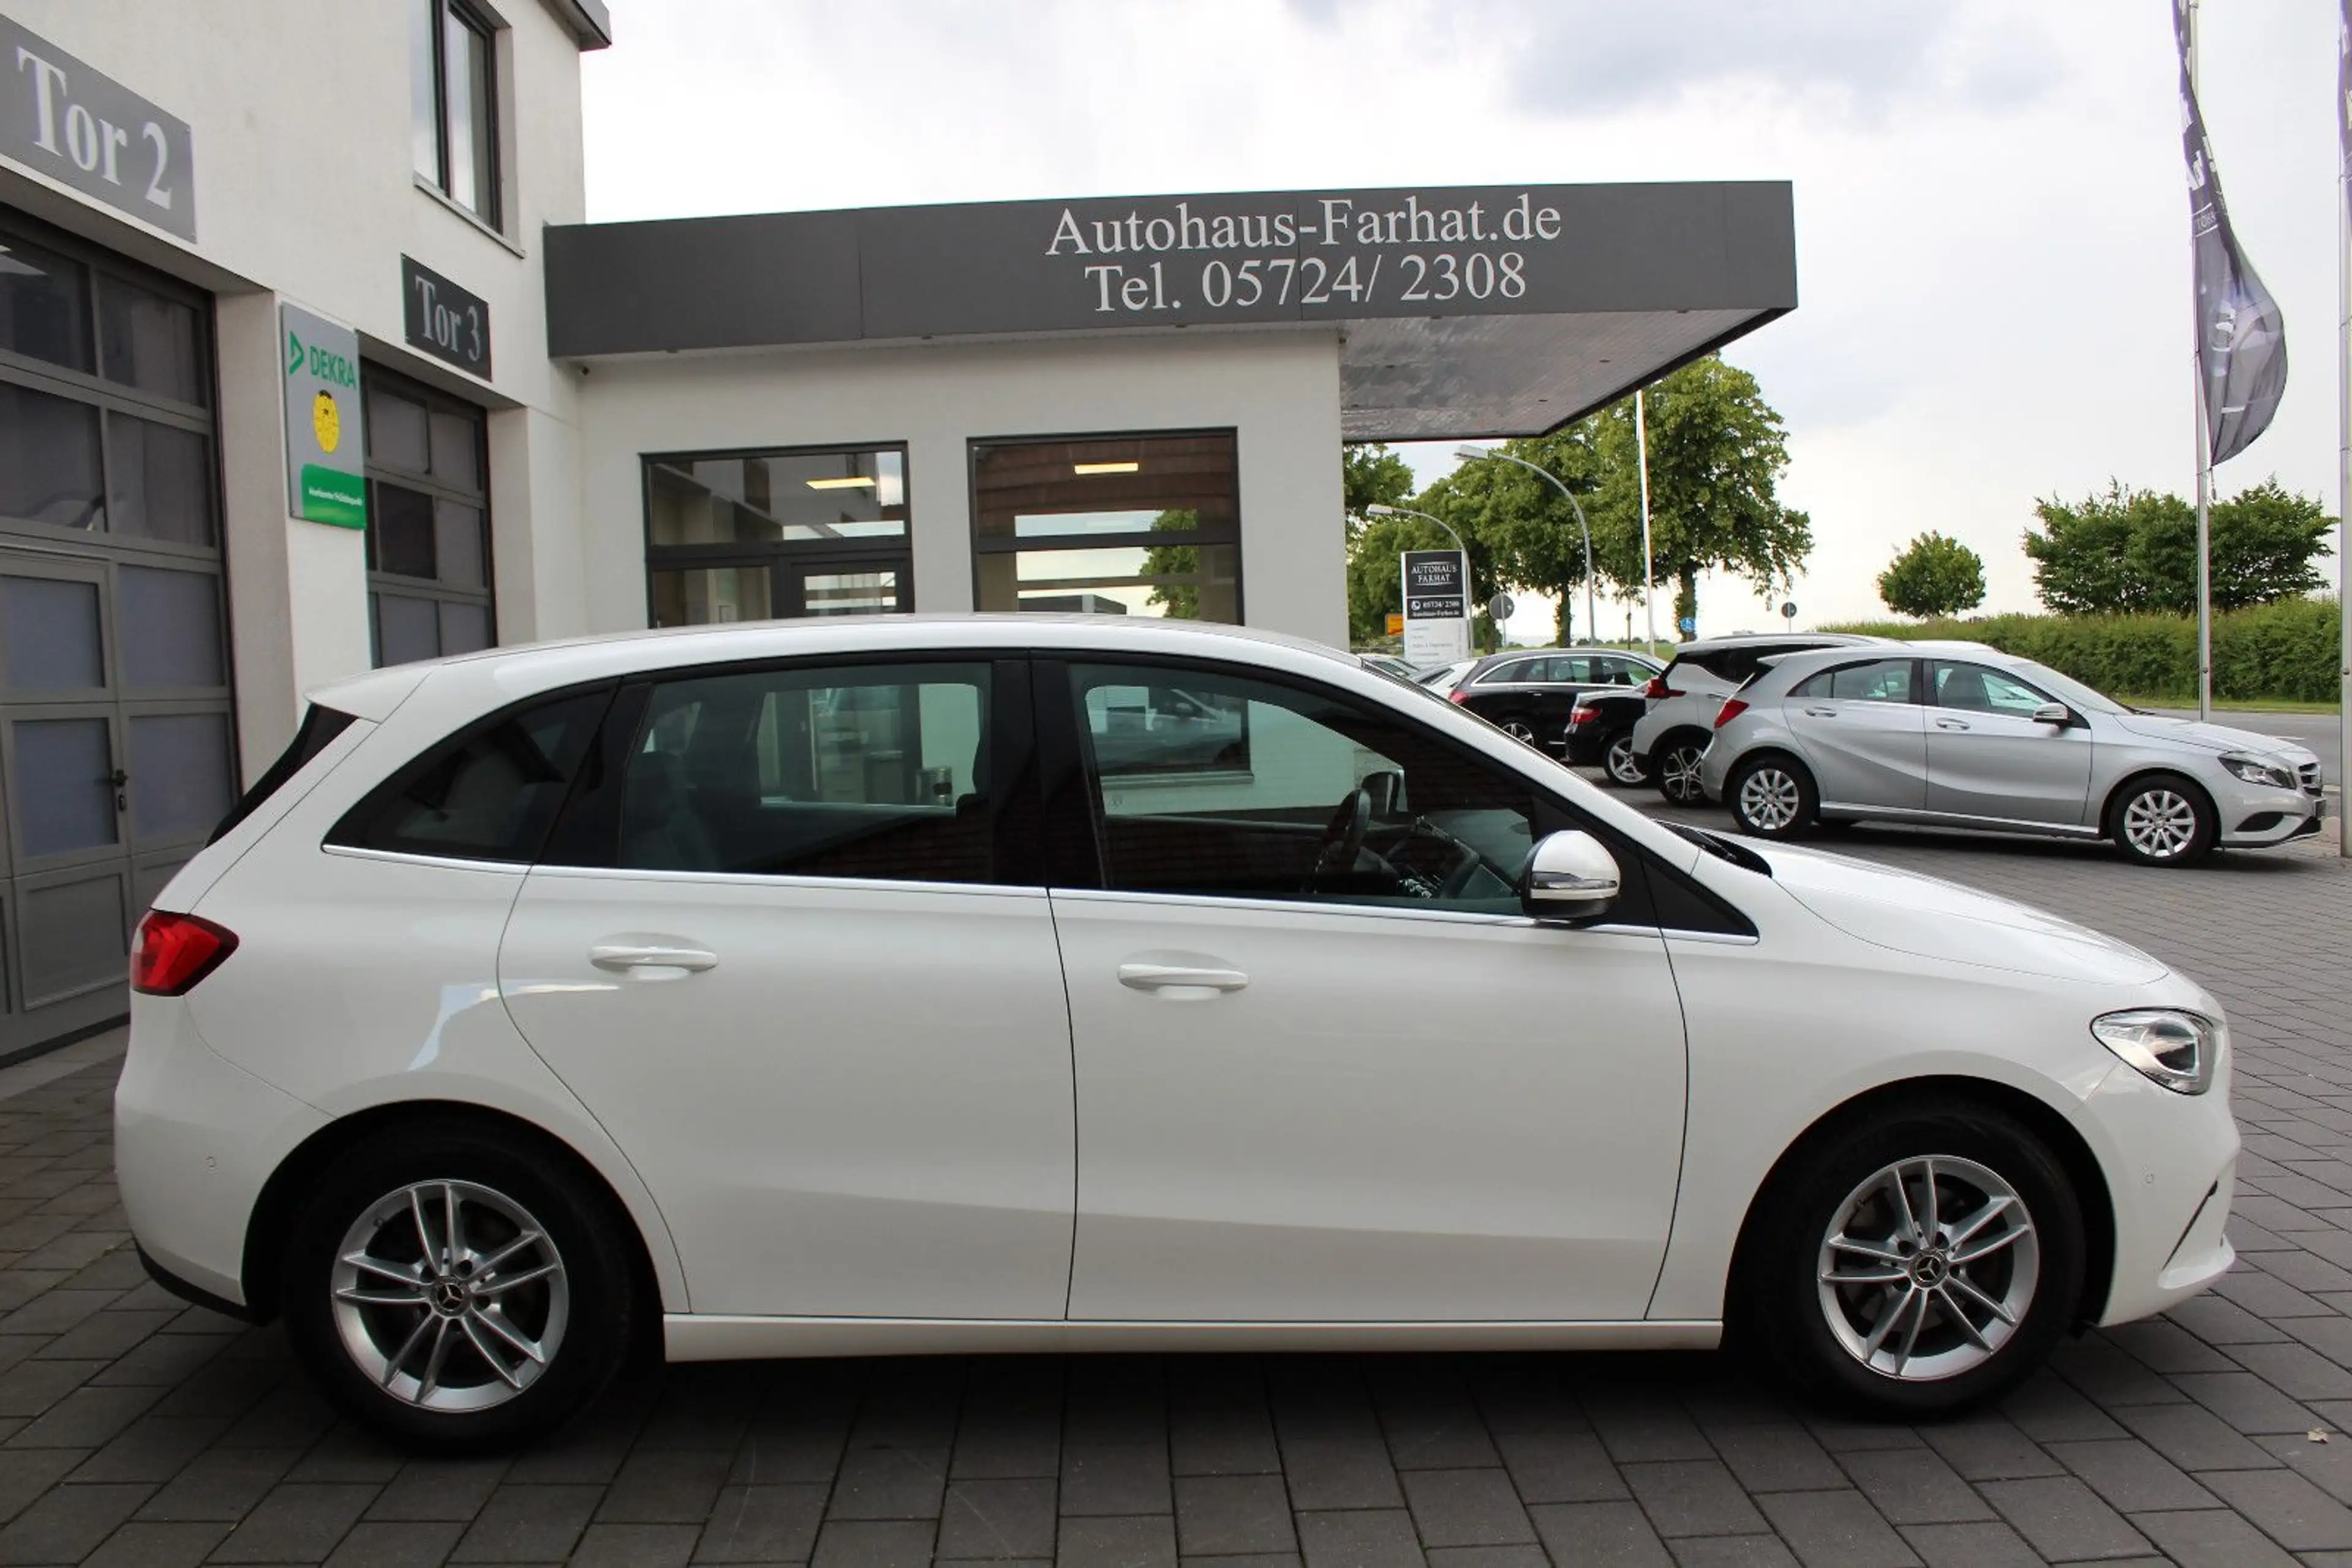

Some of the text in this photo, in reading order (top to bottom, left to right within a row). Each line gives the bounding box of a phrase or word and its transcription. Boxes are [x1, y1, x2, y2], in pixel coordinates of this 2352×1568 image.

[17, 46, 172, 209] Tor 2
[1045, 192, 1561, 256] Autohaus-Farhat.de
[1084, 252, 1526, 311] Tel. 05724/ 2308
[415, 274, 481, 361] Tor 3
[309, 345, 357, 389] DEKRA
[1411, 564, 1458, 575] AUTOHAUS
[1417, 573, 1450, 584] FARHAT
